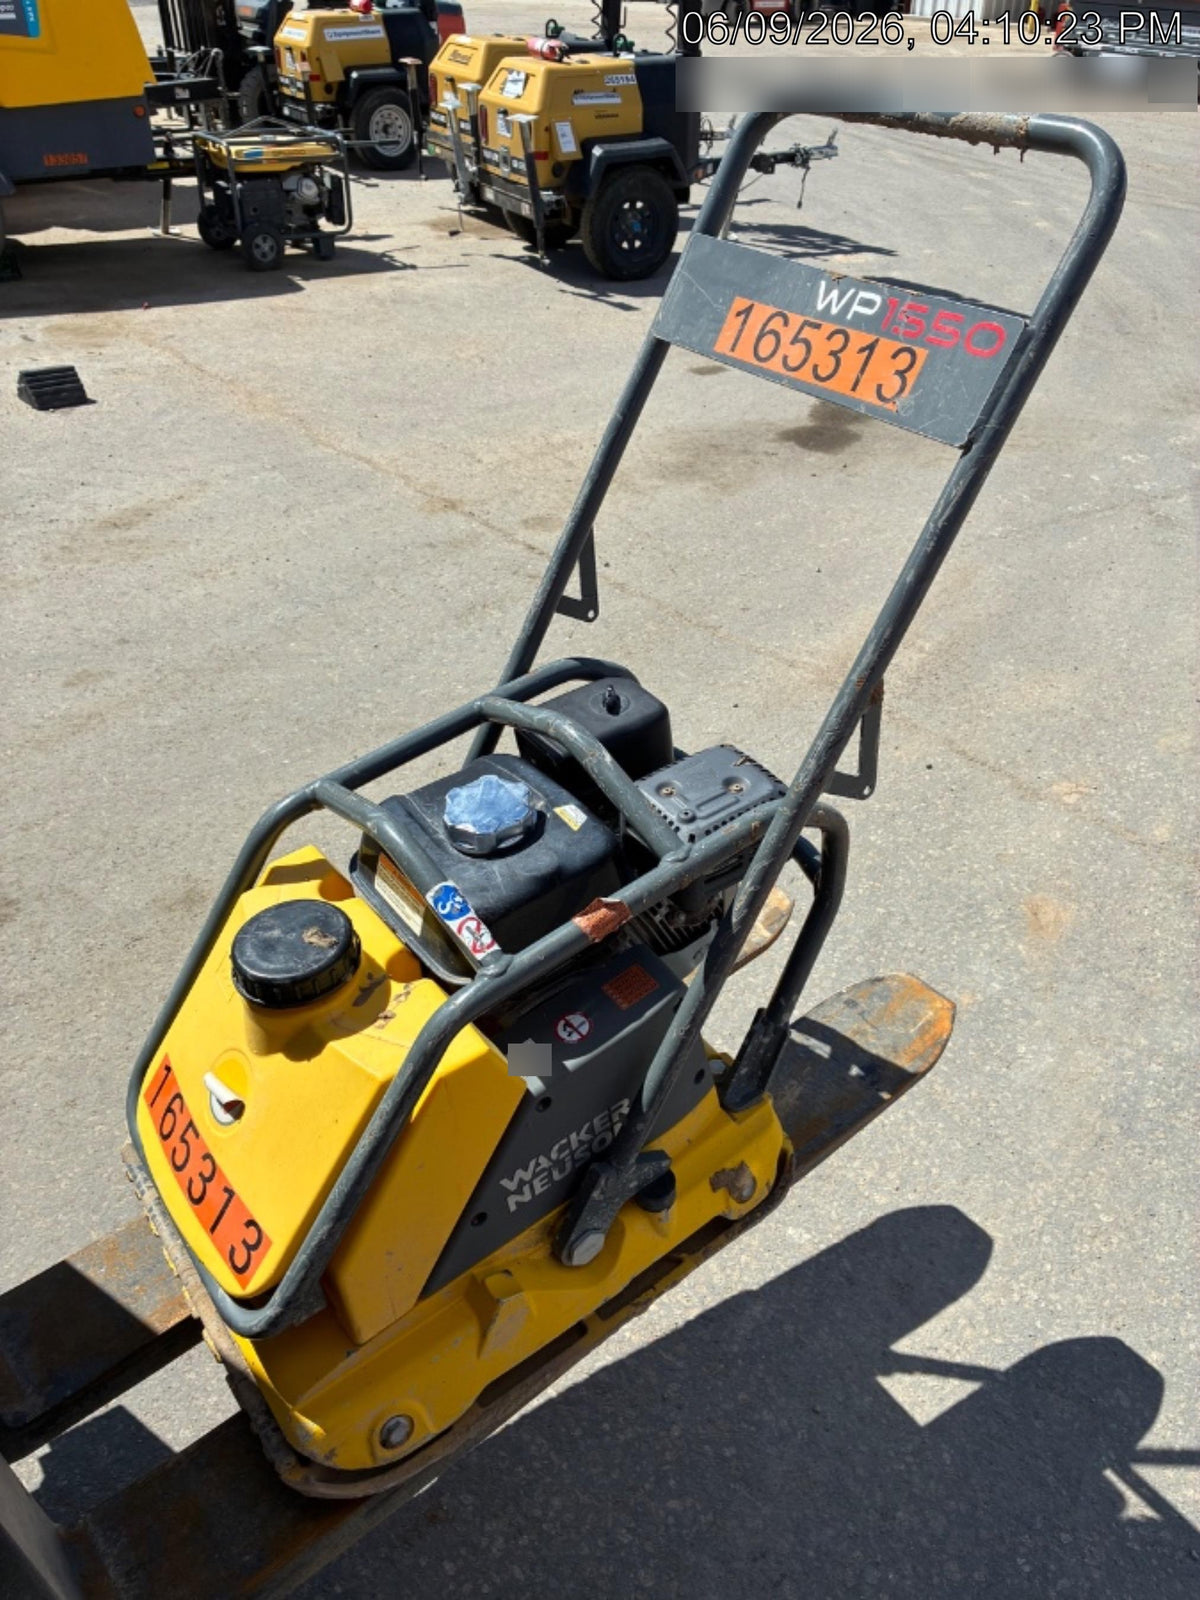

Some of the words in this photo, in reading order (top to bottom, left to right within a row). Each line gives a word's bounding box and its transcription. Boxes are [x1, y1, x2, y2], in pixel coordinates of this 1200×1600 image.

[729, 302, 919, 405] 165313
[815, 280, 1007, 358] WP1550
[149, 1063, 264, 1276] 165313
[499, 1097, 630, 1192] WACKER
